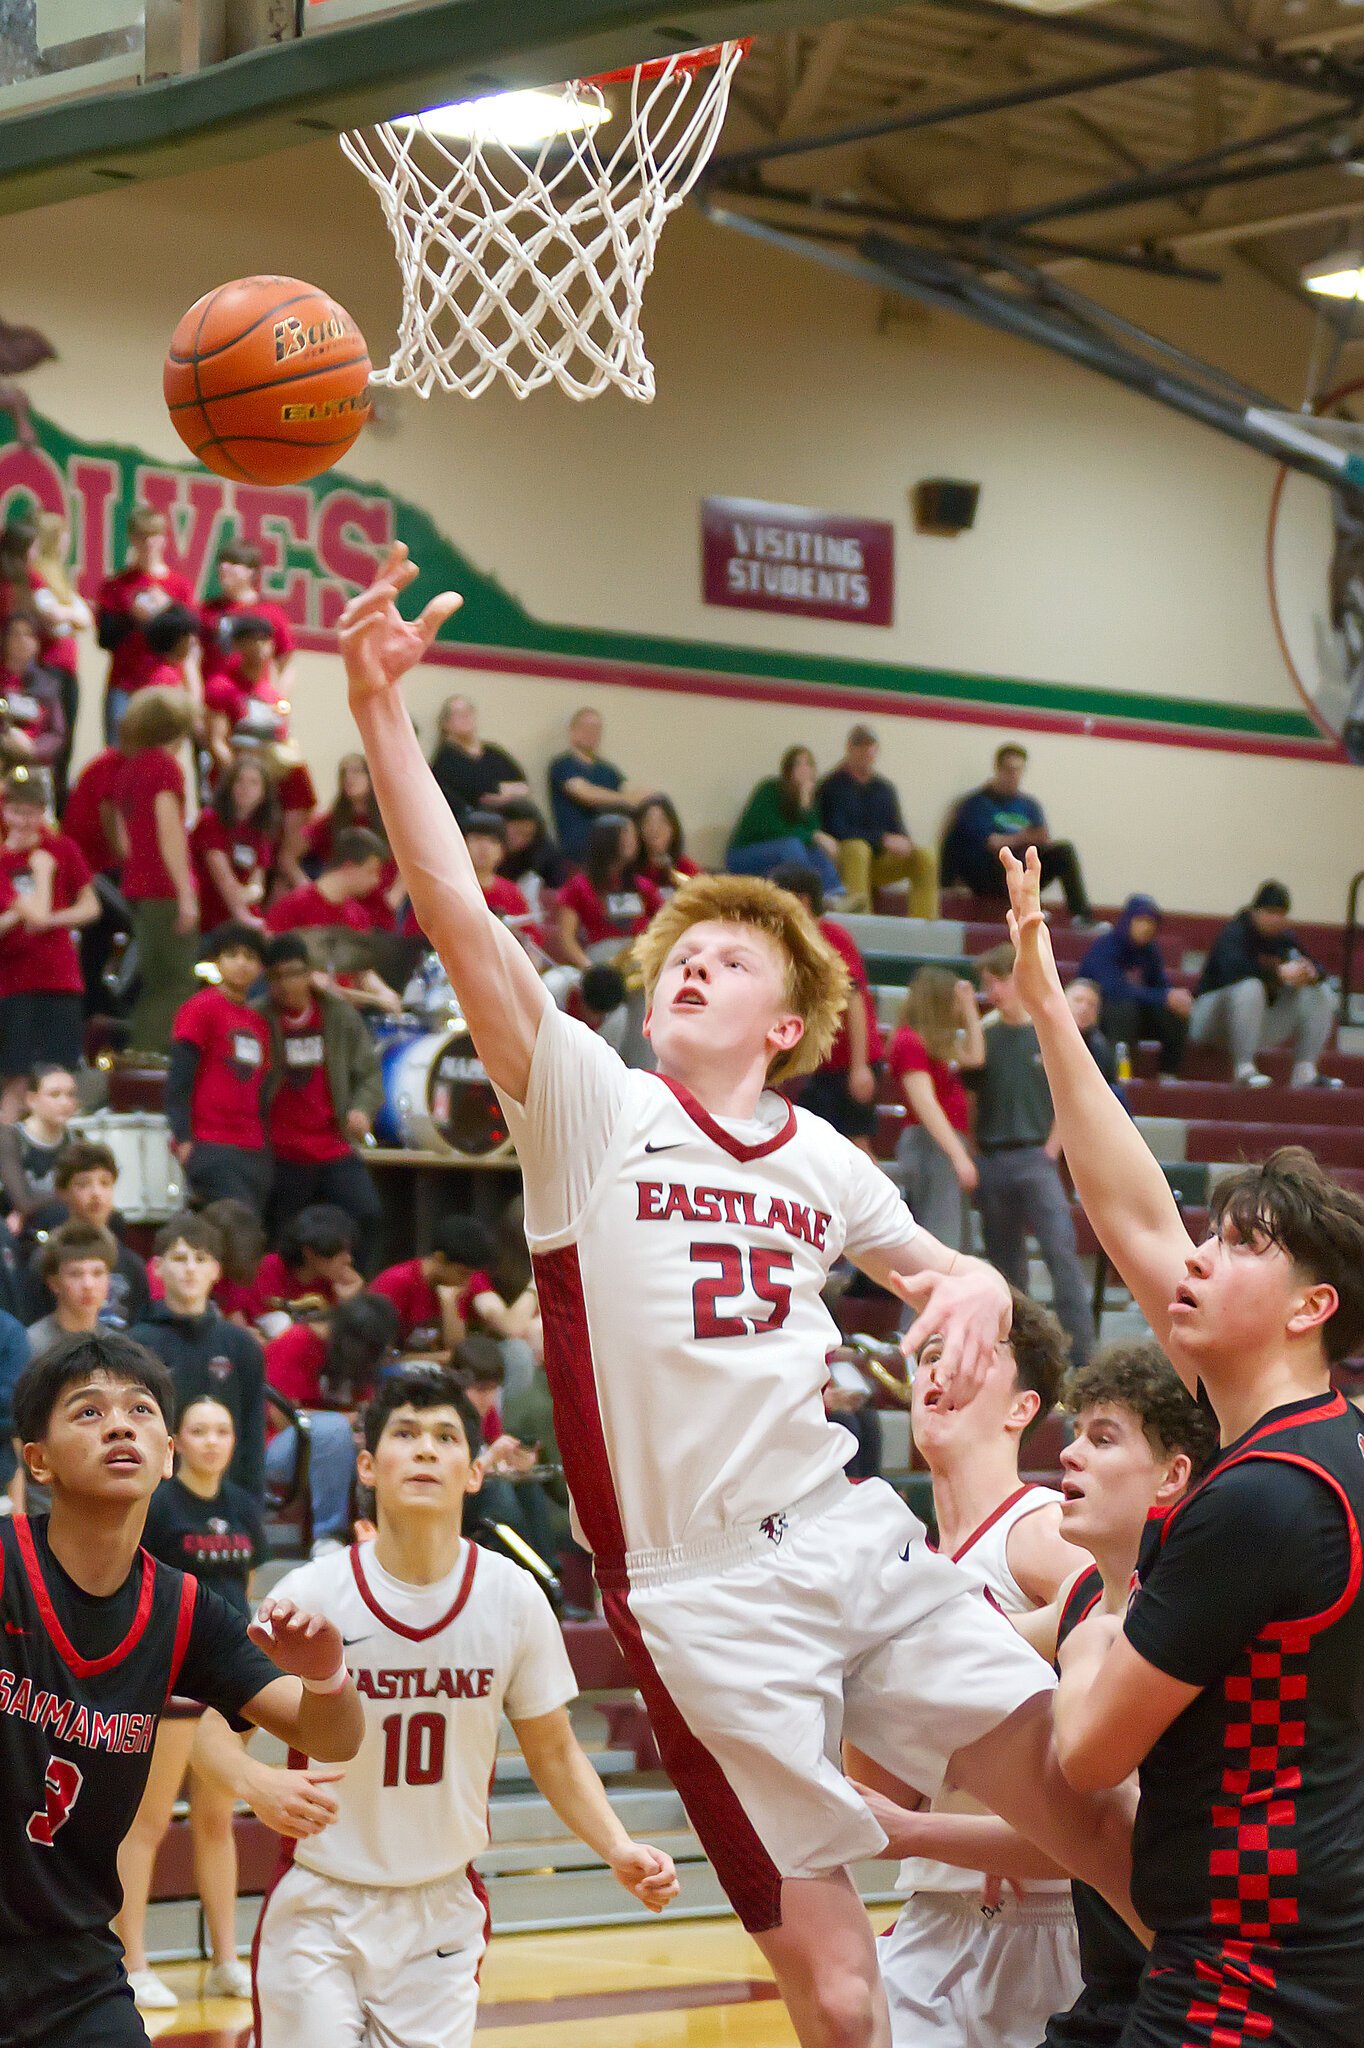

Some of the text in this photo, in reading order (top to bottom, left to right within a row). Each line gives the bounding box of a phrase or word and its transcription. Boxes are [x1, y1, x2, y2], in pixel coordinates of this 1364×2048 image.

[732, 522, 864, 570] VISITING
[727, 557, 870, 610] STUDENTS
[636, 1181, 832, 1252] EASTLAKE
[690, 1241, 795, 1340] 25
[348, 1667, 495, 1699] ASTLAKE
[382, 1711, 447, 1788] 10
